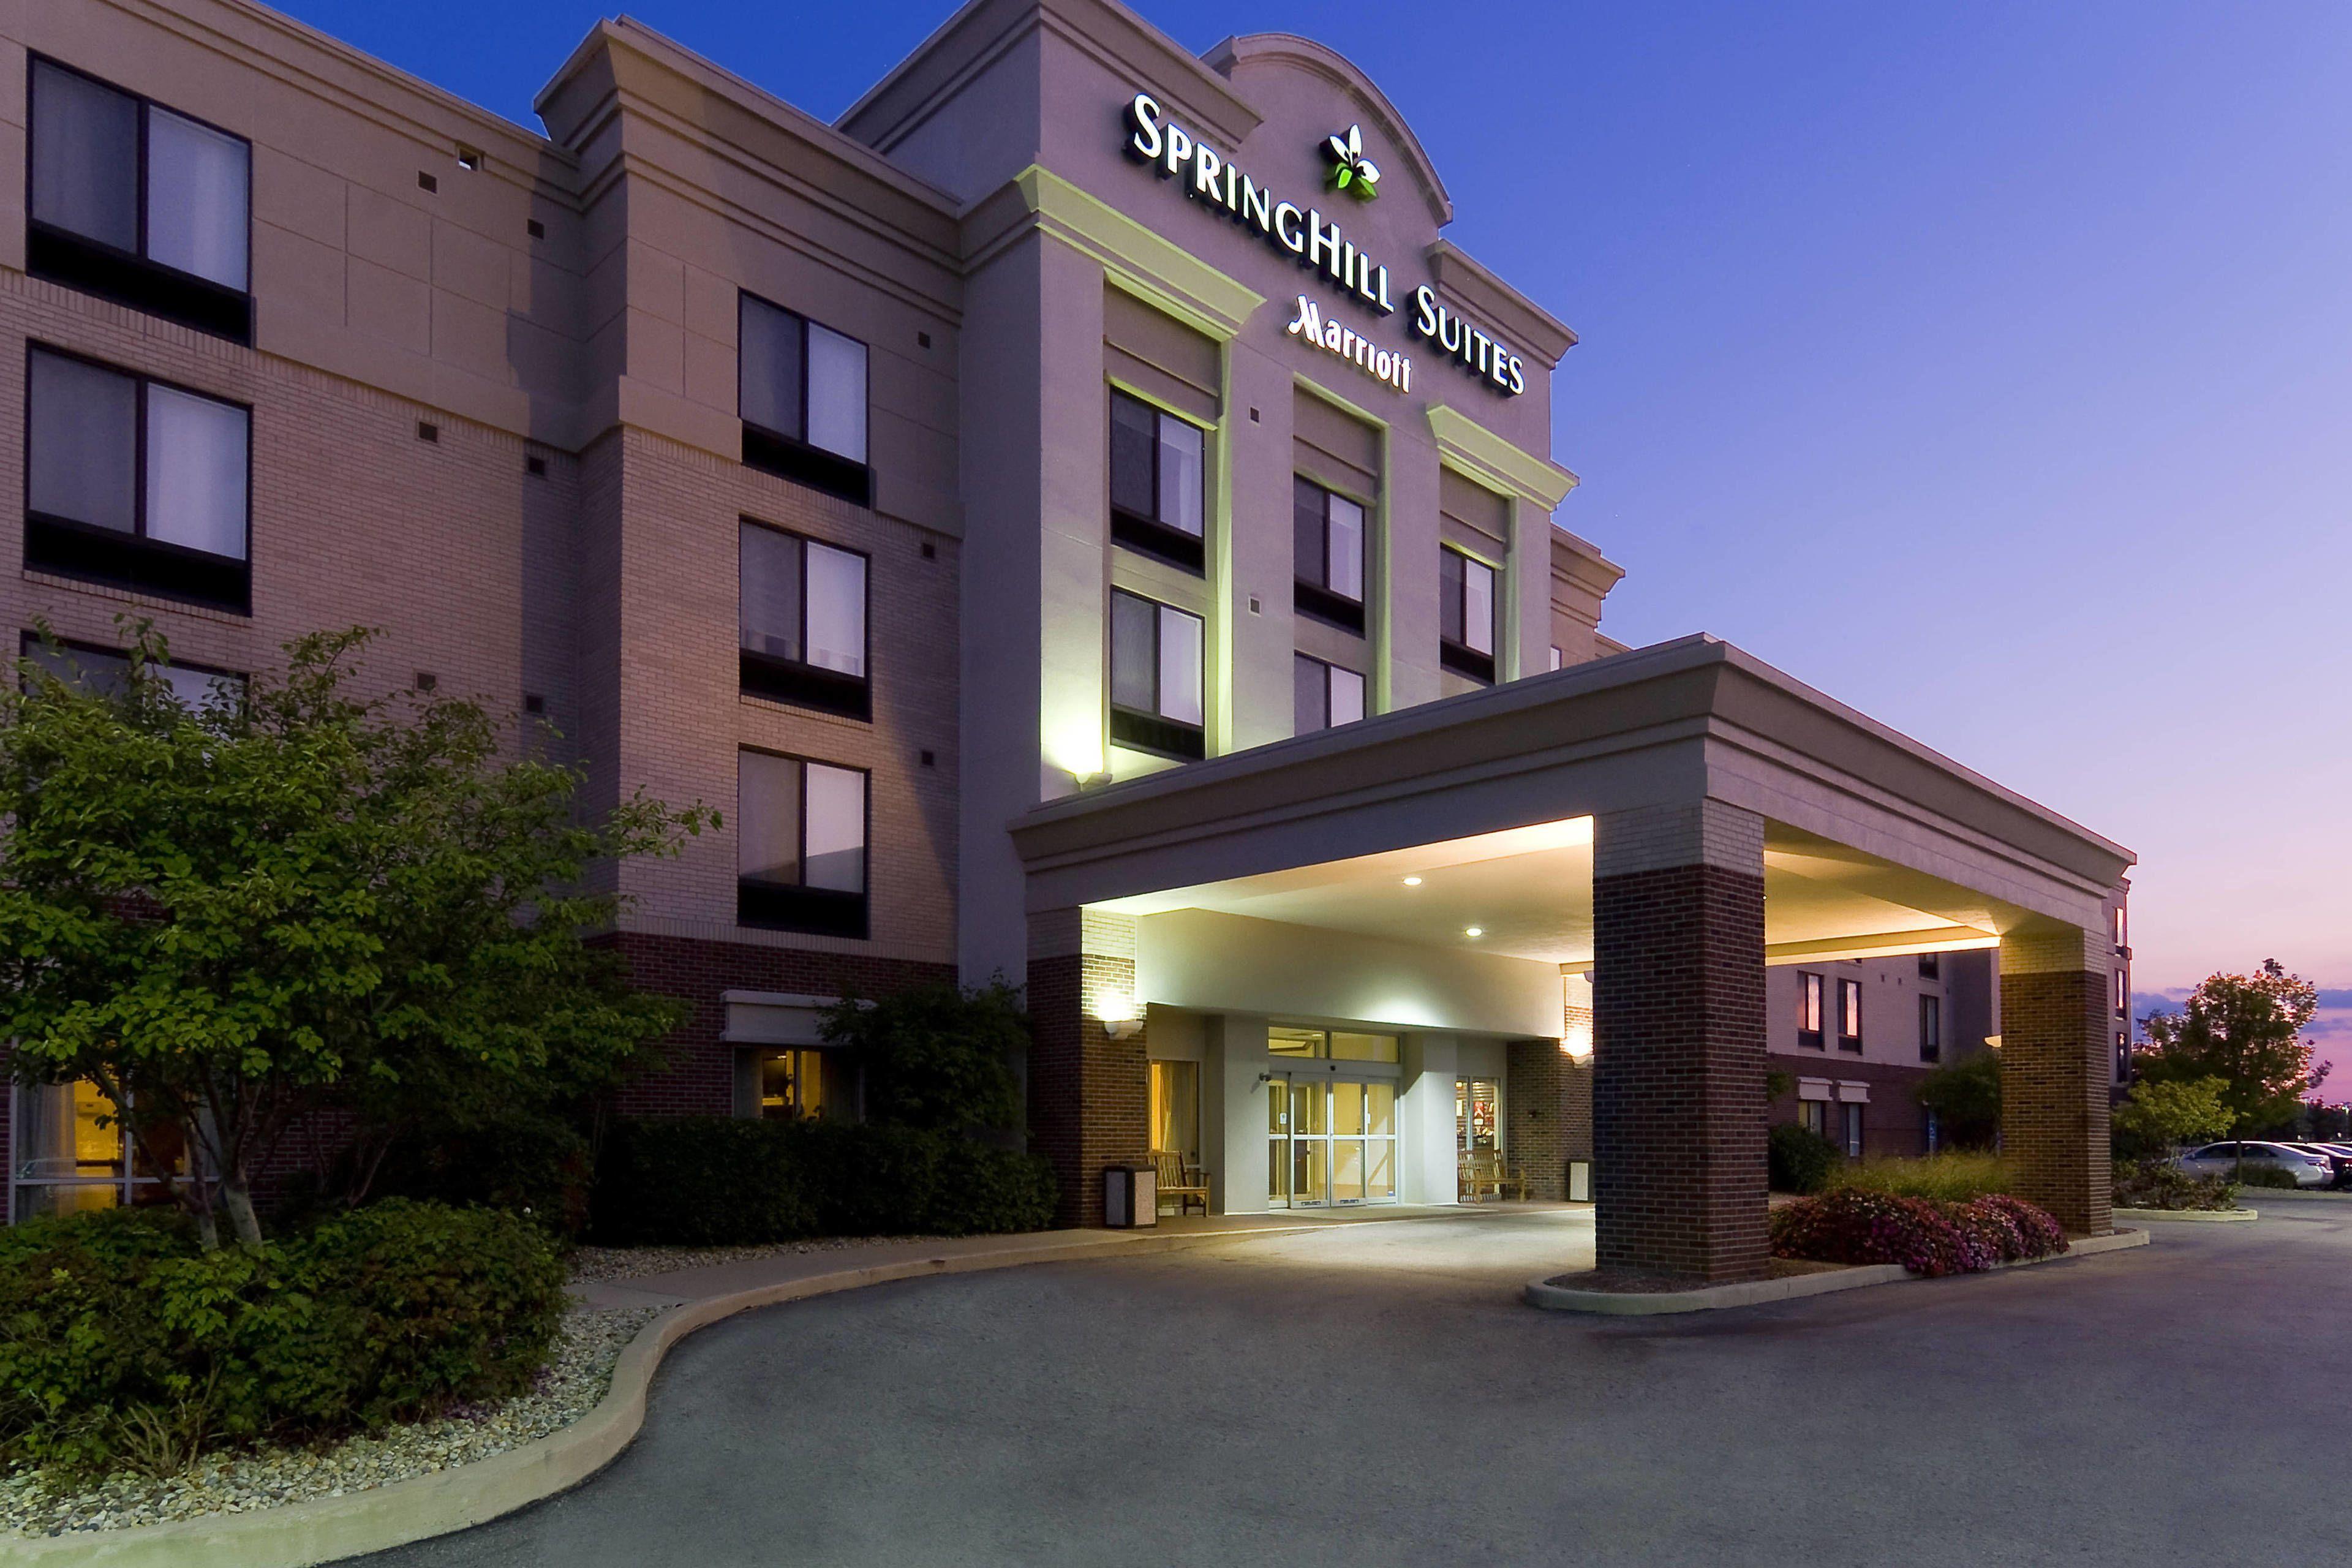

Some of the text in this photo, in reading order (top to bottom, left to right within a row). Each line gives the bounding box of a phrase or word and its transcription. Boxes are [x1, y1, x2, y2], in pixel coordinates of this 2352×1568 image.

[1133, 94, 1525, 395] SPRINGHILL SUITES
[1287, 295, 1411, 394] Marriott
